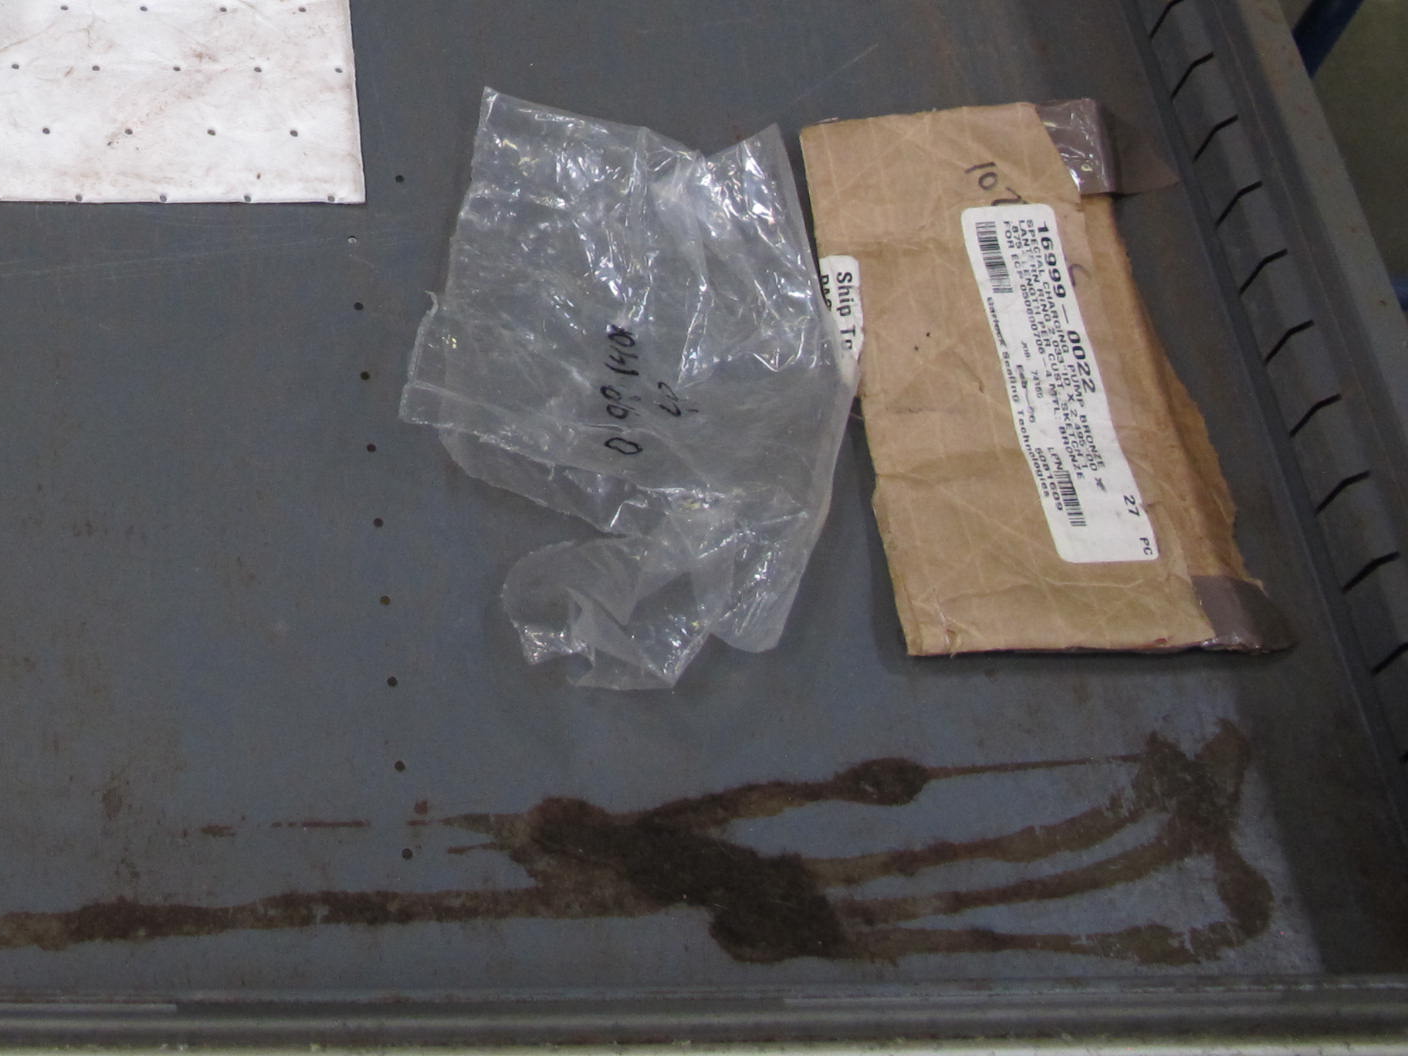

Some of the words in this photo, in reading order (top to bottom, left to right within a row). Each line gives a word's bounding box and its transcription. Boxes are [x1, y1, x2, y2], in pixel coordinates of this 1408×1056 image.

[836, 272, 854, 316] Ship
[1035, 288, 1051, 322] RING
[1000, 220, 1016, 248] FOR
[1057, 425, 1084, 480] BRONZE
[1023, 219, 1048, 275] SPECIAL
[1041, 281, 1069, 353] CHARGING
[1066, 364, 1085, 407] PUMP
[1078, 414, 1105, 469] BRONZE
[1037, 321, 1050, 346] PER
[1059, 402, 1083, 456] SKETCH
[999, 351, 1022, 402] Sealing
[1014, 408, 1050, 498] Technologies
[1047, 446, 1063, 470] LPN
[1123, 494, 1140, 517] 27
